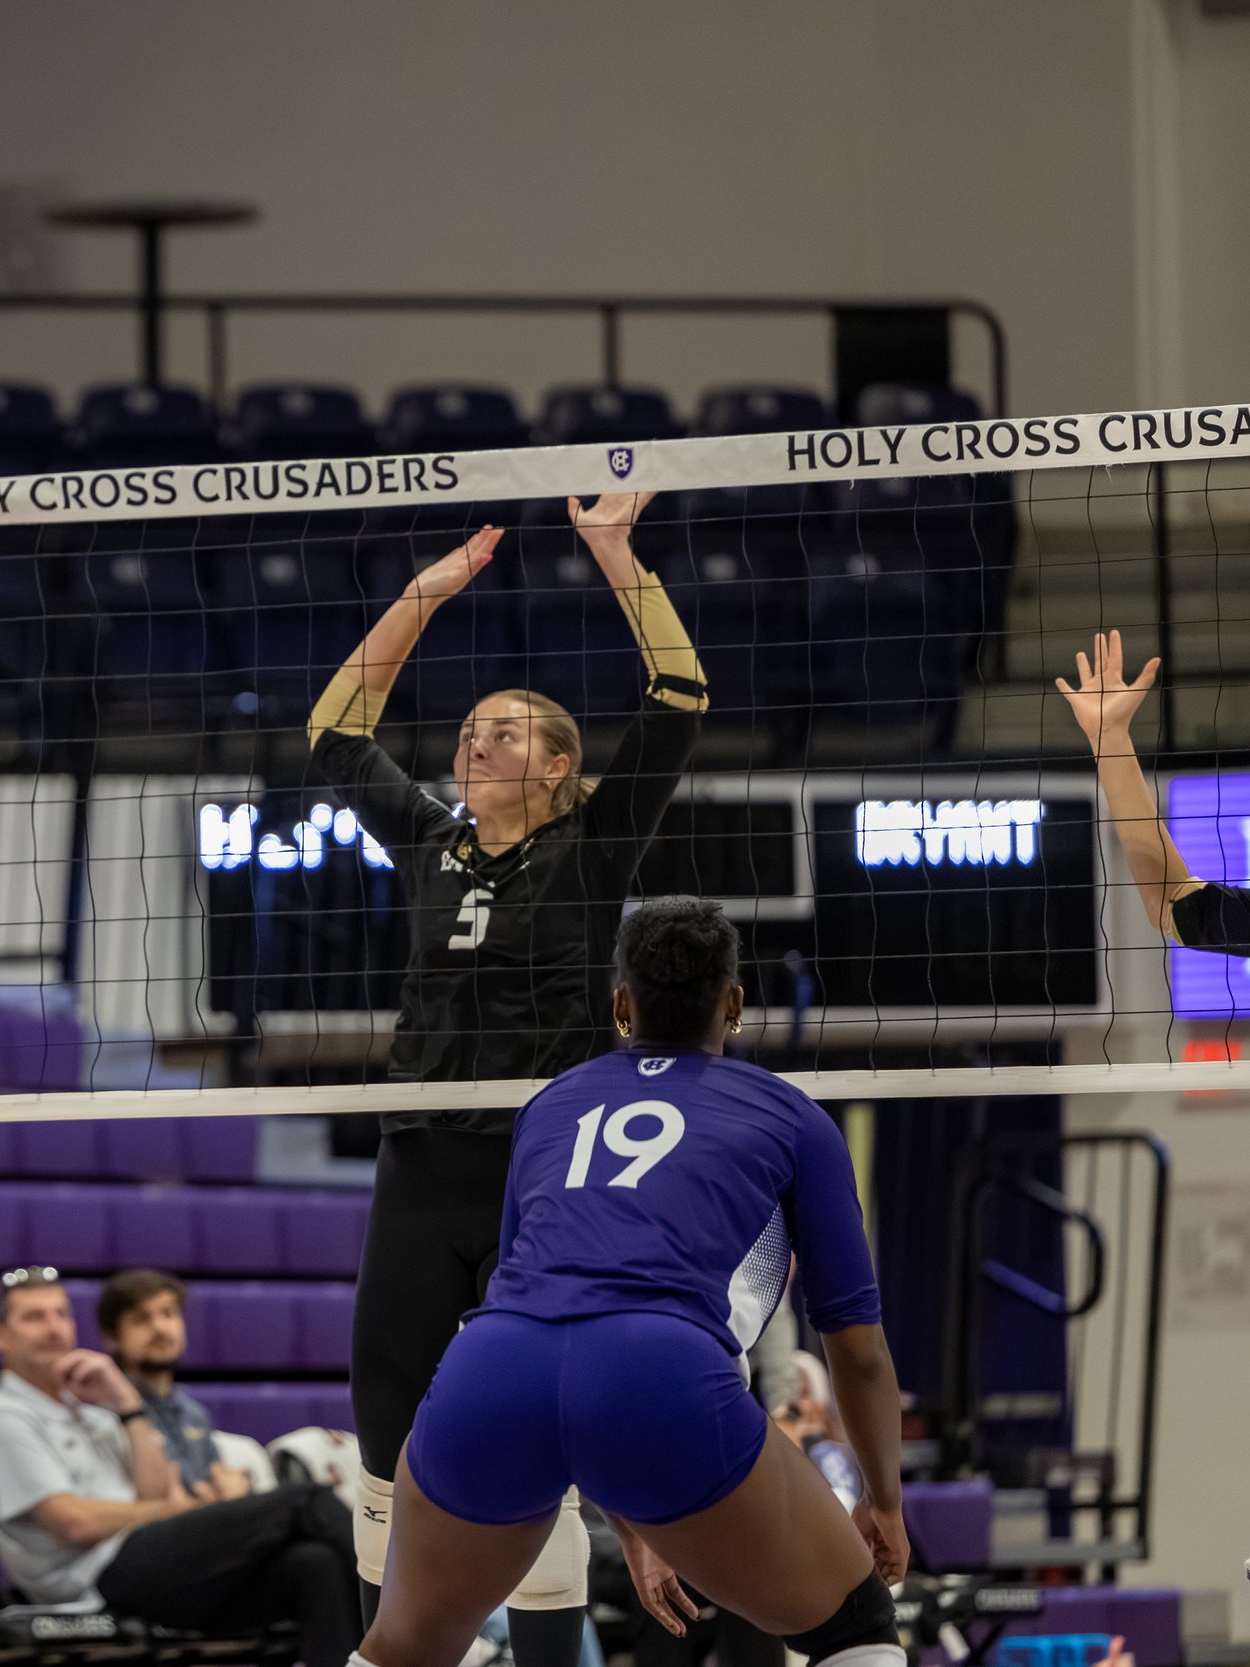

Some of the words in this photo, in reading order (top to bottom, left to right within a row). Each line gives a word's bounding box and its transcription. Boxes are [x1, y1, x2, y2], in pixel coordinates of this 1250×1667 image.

[786, 427, 908, 471] HOLY
[921, 417, 1081, 462] CROSS
[29, 469, 177, 511] CROSS
[192, 455, 460, 502] CRUSADERS
[447, 887, 495, 951] 5
[564, 1099, 686, 1189] 19
